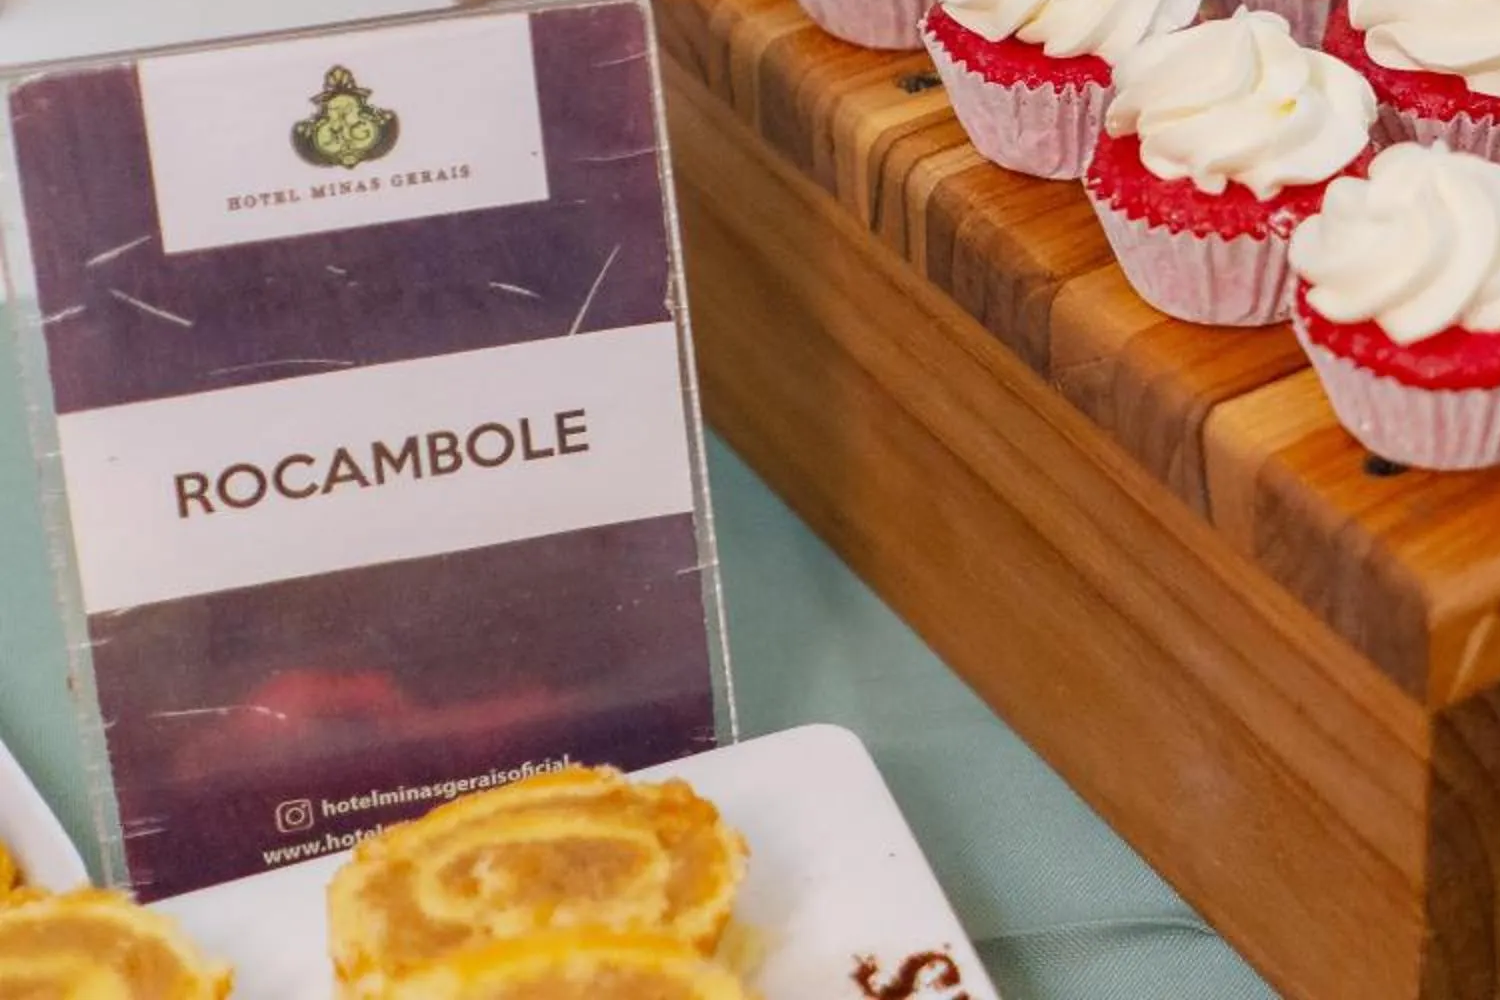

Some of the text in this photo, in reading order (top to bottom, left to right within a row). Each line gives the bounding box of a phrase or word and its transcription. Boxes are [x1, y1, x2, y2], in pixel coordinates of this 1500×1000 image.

[226, 163, 471, 213] HOTEL MINAS GERAIS
[173, 408, 590, 519] ROCAMBOLE
[322, 753, 570, 818] hotelminasgeraisoficial
